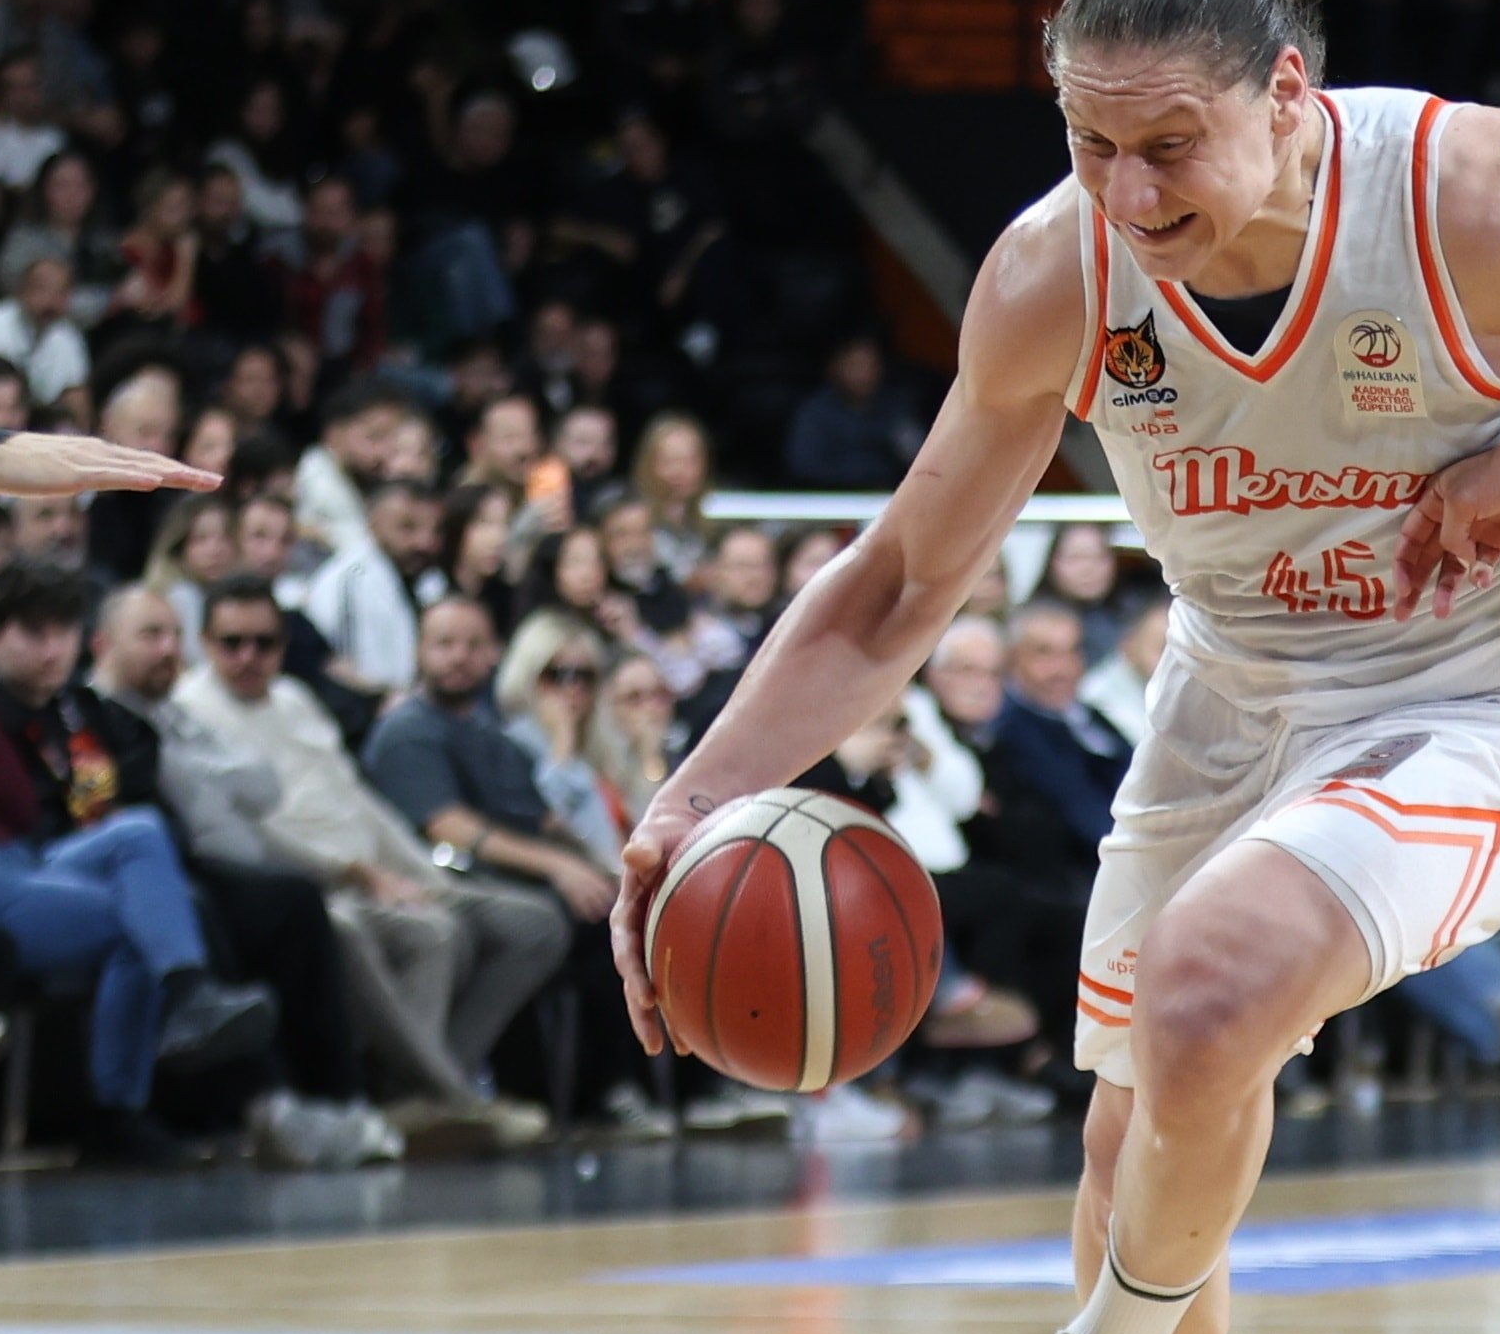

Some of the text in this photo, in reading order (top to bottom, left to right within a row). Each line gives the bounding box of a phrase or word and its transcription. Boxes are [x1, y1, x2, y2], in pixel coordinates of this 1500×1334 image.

[1355, 369, 1417, 383] HALKBANK
[1354, 385, 1410, 397] KADINLAR
[1351, 393, 1416, 406] BASKETBOL
[1131, 422, 1179, 437] upa
[1153, 446, 1431, 517] Mersin
[1261, 540, 1387, 620] 45
